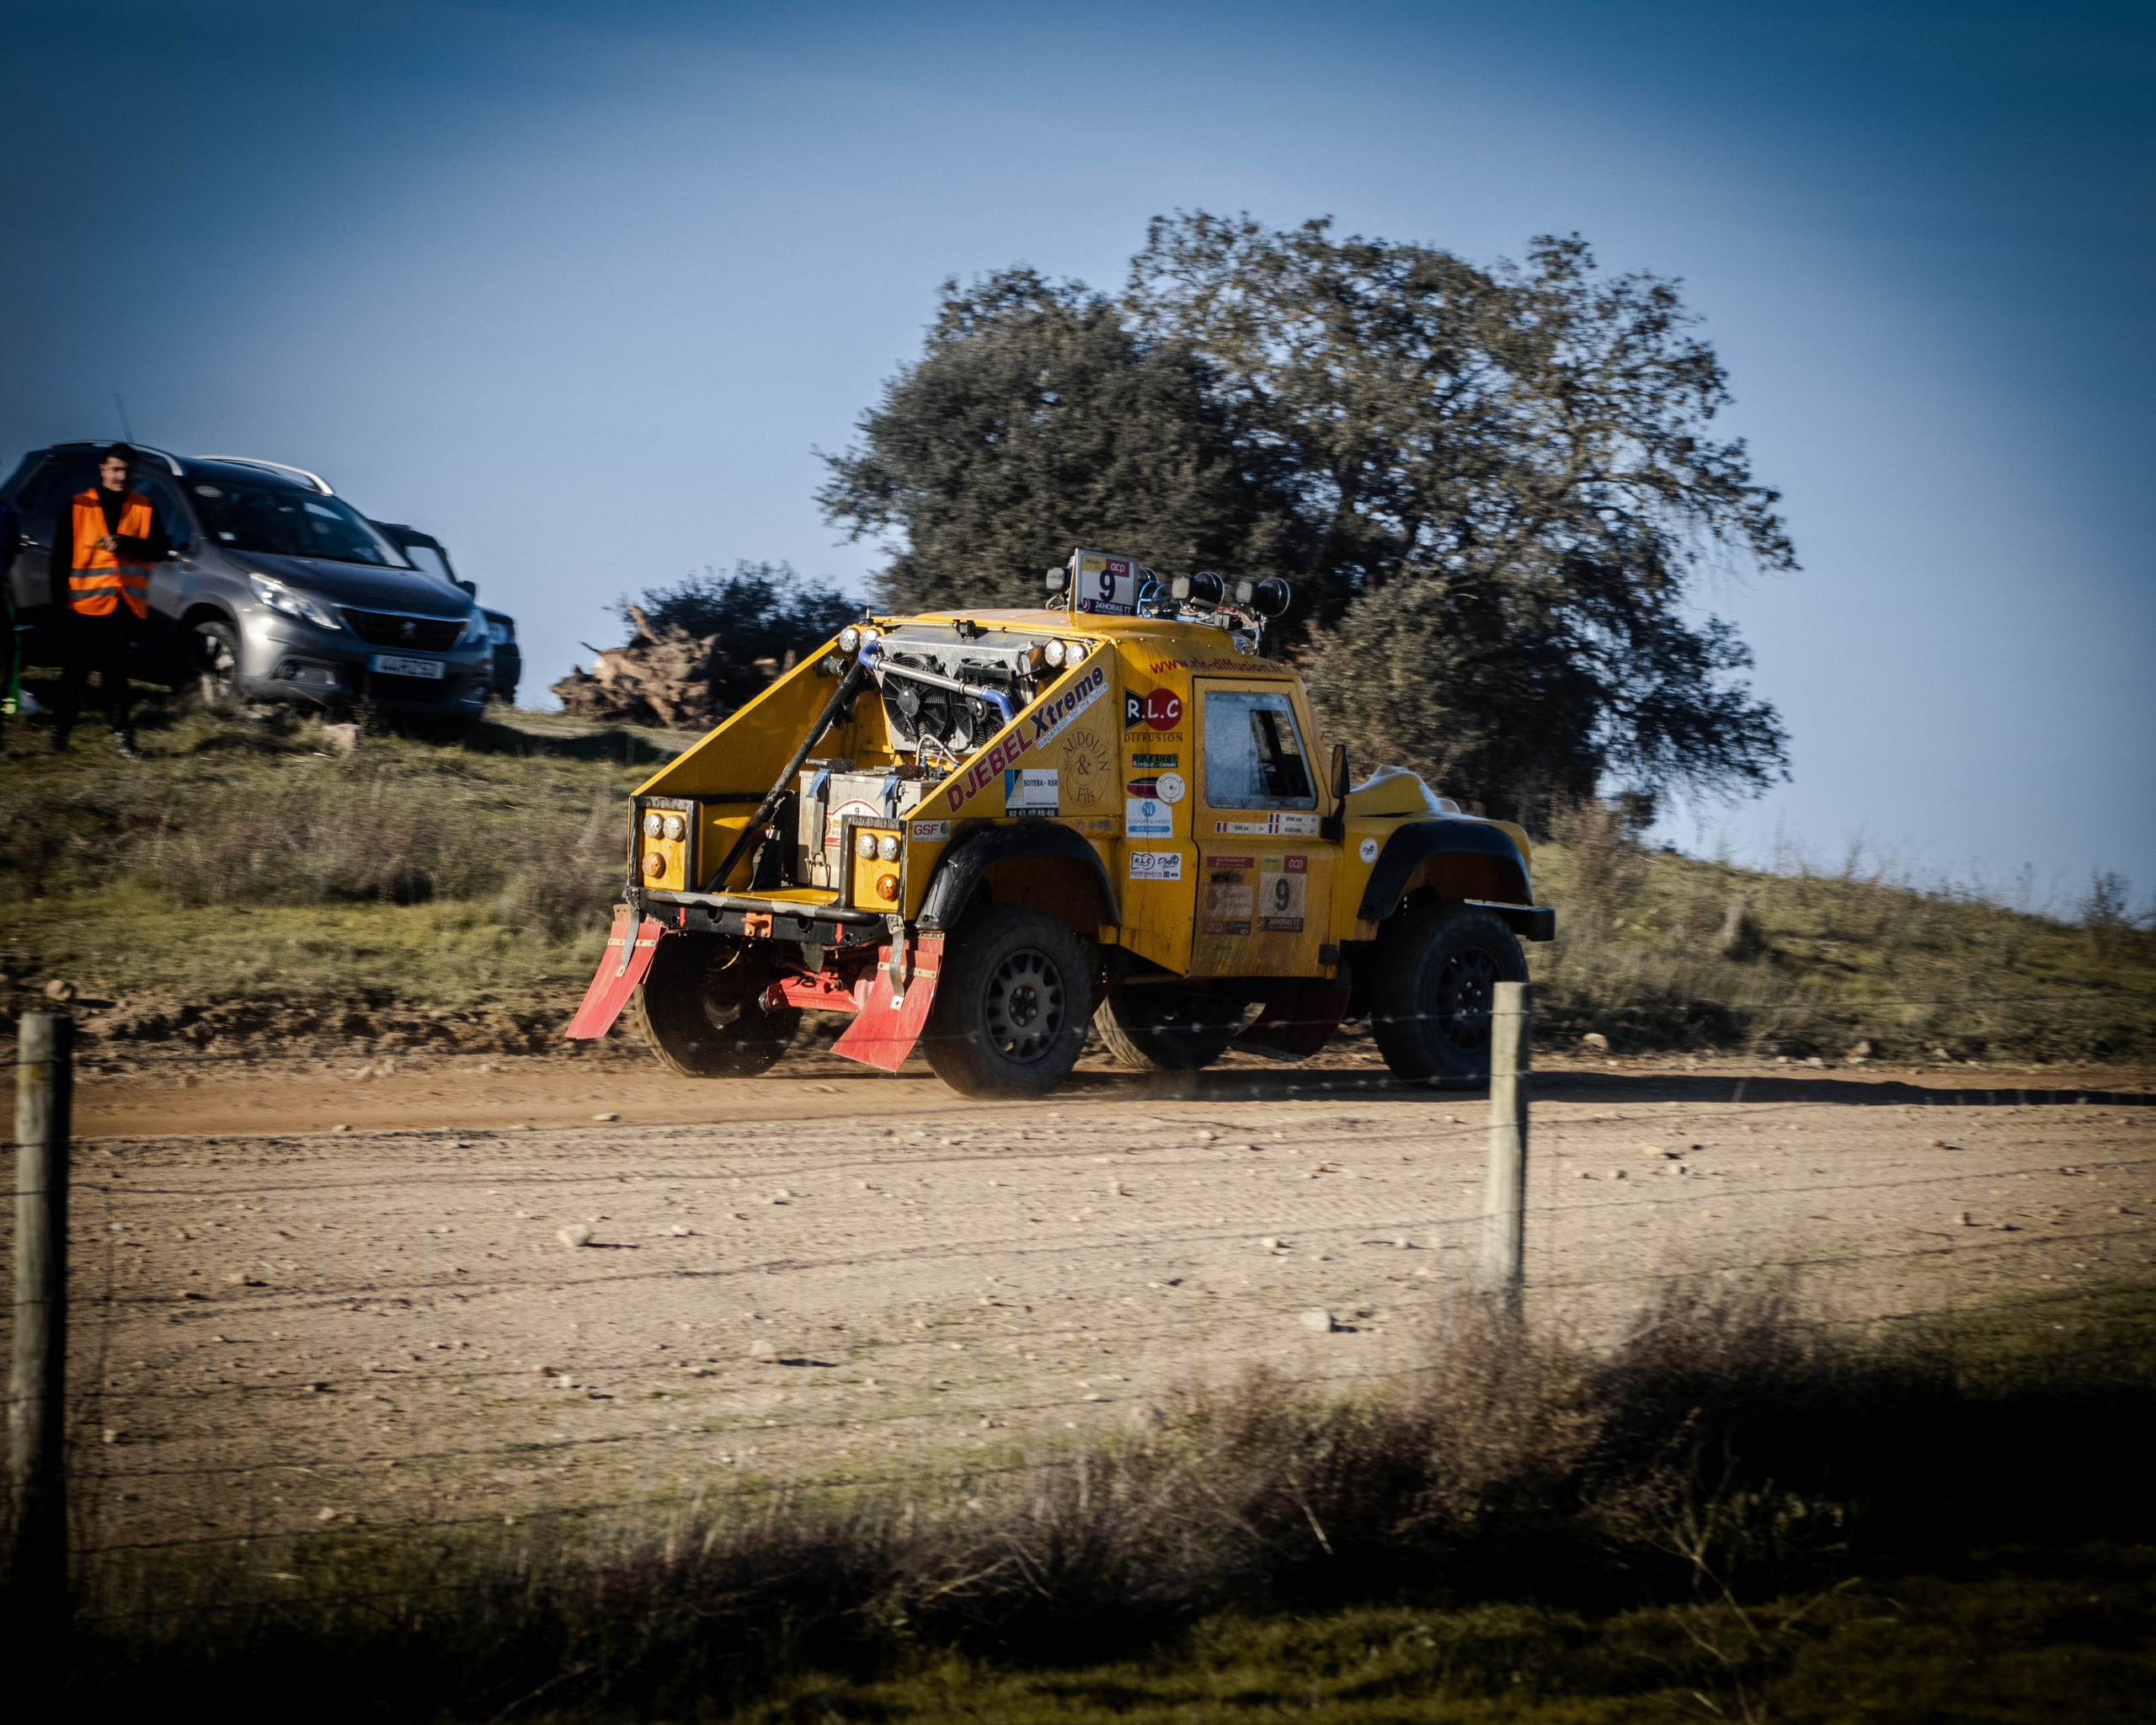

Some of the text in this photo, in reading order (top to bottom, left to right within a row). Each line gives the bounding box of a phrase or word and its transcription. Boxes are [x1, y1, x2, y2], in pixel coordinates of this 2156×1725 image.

[1110, 563, 1125, 574] acp
[1099, 569, 1115, 602] 9
[1150, 657, 1283, 674] www.rlc-diffusion.fr
[1037, 683, 1107, 748] suspension for the future
[1128, 699, 1178, 718] R.L.C
[946, 666, 1104, 814] DJEBEL Xtreme
[1124, 734, 1183, 742] DIFFUSION
[1063, 731, 1109, 771] AUDOUIN
[1133, 754, 1177, 762] HOLESHOT
[1078, 755, 1090, 775] &
[1077, 787, 1095, 804] Fils
[914, 825, 939, 835] GSF
[1289, 859, 1304, 869] acp
[1275, 879, 1289, 911] 9
